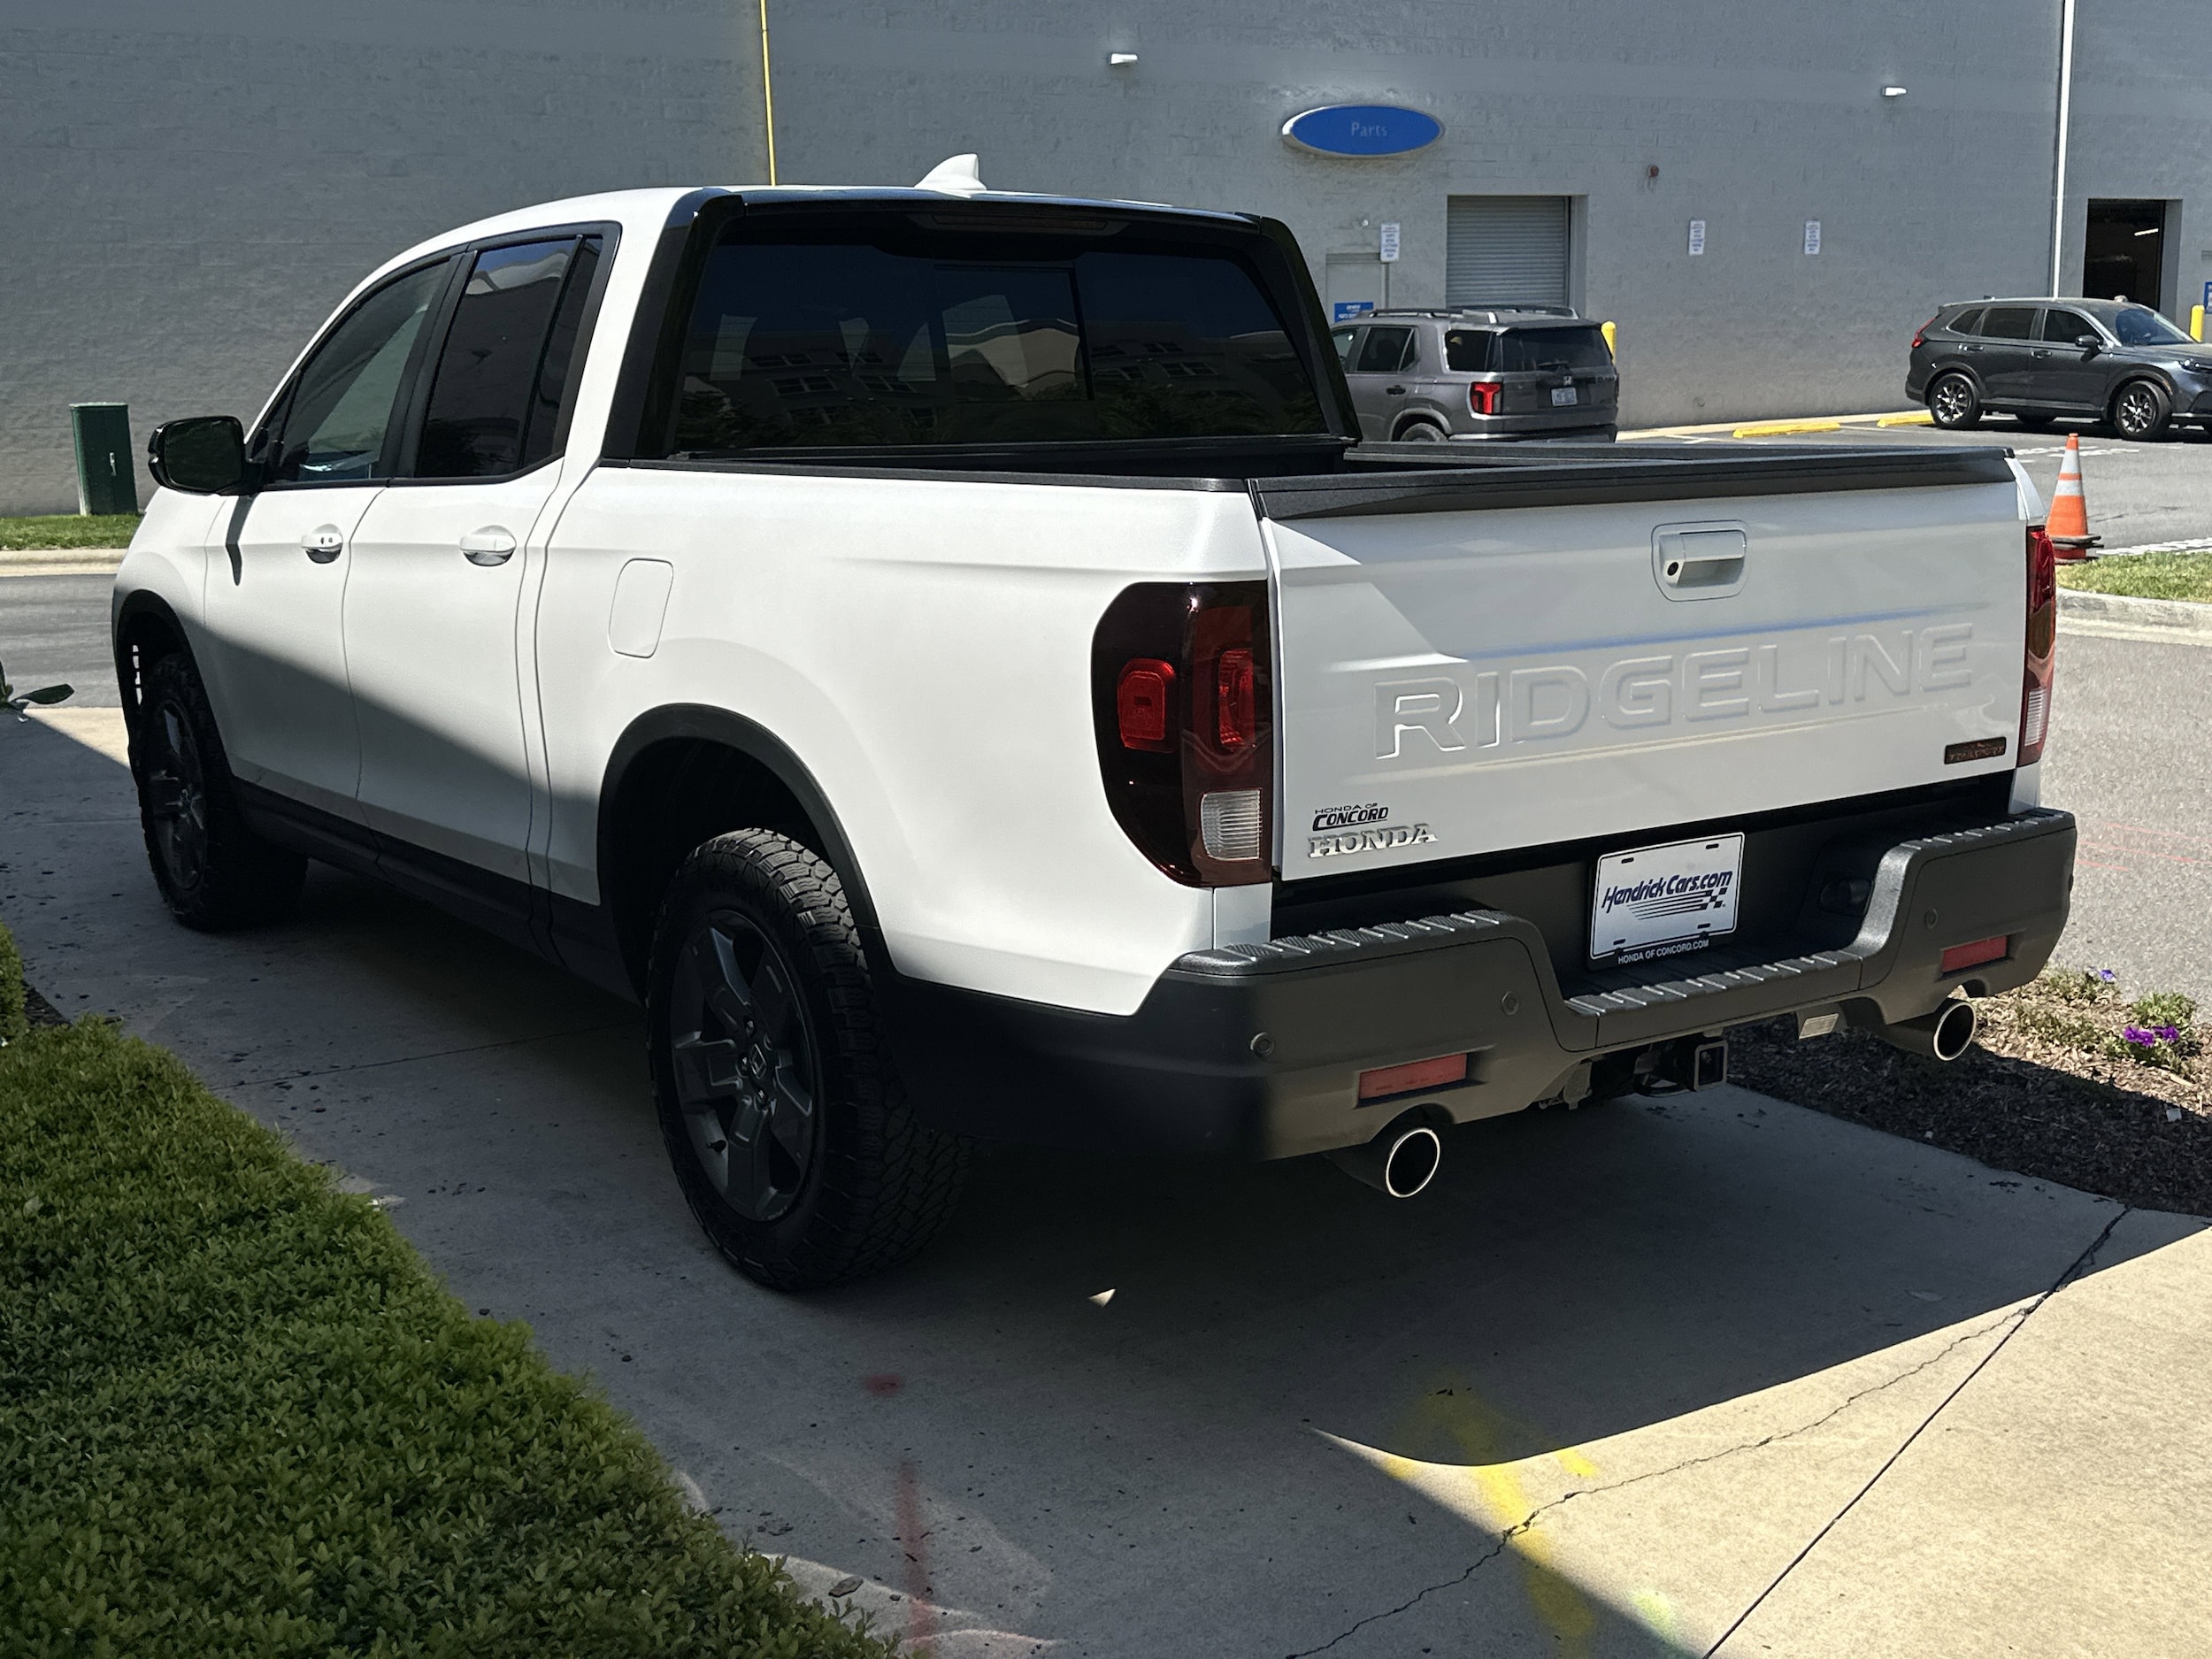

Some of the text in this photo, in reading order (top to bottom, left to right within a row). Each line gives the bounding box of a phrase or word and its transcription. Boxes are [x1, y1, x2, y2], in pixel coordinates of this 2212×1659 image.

[1350, 121, 1388, 137] Parts
[1372, 622, 1973, 759] RIDGELINE
[1312, 806, 1389, 831] CONCORD
[1314, 804, 1363, 814] HONDA
[1309, 823, 1439, 858] HONDA
[1617, 939, 1709, 965] HONDA OF CONCORD.COM
